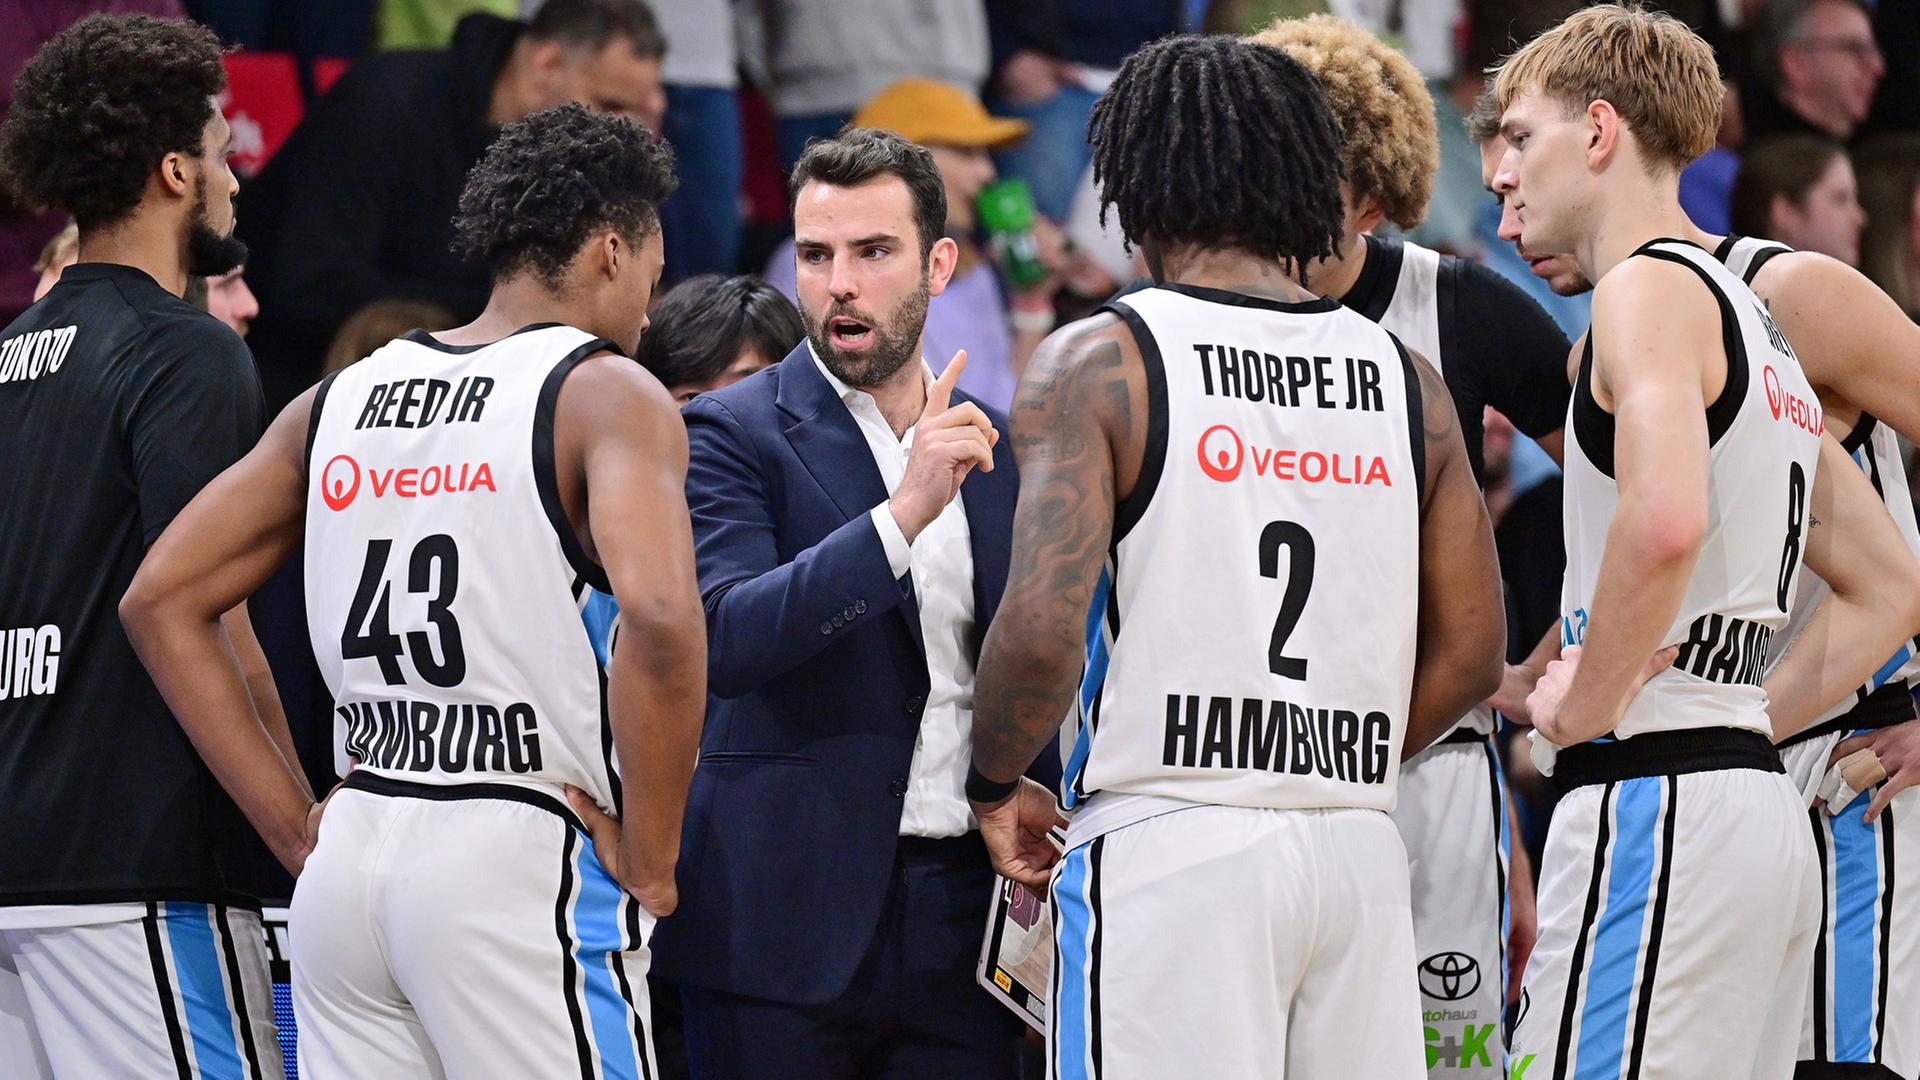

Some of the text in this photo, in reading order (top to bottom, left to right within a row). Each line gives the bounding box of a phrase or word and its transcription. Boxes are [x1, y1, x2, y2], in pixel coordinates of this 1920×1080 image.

[0, 325, 78, 384] TOKOTO
[1193, 344, 1384, 412] THORPE JR
[355, 376, 495, 430] REED JR
[369, 463, 497, 498] VEOLIA
[1251, 446, 1392, 487] VEOLIA
[1776, 461, 1805, 613] 8
[341, 534, 466, 688] 43
[1259, 520, 1315, 681] 2
[1672, 612, 1775, 687] HAMB
[336, 700, 543, 773] HAMBURG
[1162, 694, 1391, 785] HAMBURG
